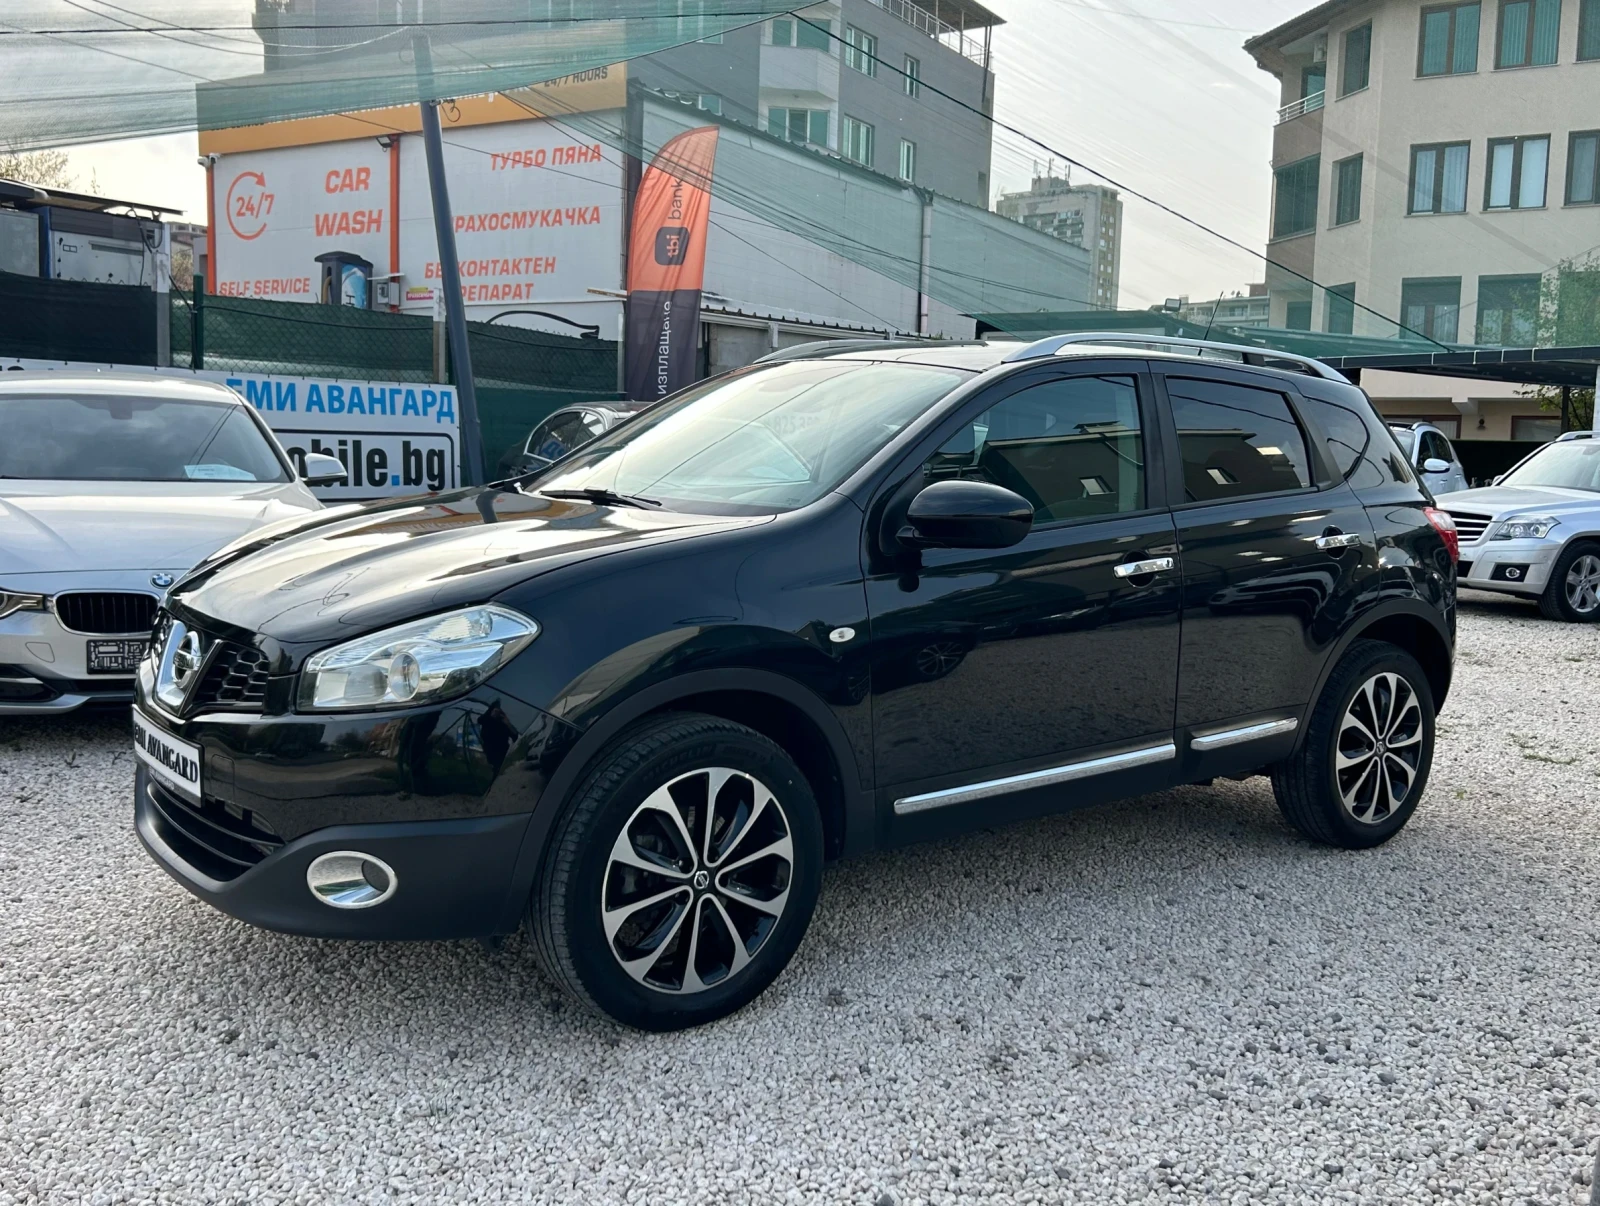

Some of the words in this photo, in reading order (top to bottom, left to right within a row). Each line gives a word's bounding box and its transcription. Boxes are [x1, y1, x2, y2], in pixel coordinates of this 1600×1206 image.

[572, 66, 608, 84] HOURS
[490, 148, 547, 171] ТУРБО
[552, 144, 602, 166] ПЯНА
[324, 166, 371, 194] CAR
[236, 194, 275, 218] 24/7
[667, 178, 684, 220] bank
[314, 209, 384, 238] WASH
[453, 206, 601, 233] РАХОСМУКАЧКА
[666, 234, 680, 258] tbi
[424, 256, 557, 280] БЕКОНТАКТЕН
[219, 280, 251, 297] SELF
[253, 277, 311, 296] SERVICE
[460, 282, 535, 302] РЕПАРАТ
[305, 383, 455, 424] АВАНГАРД
[147, 733, 199, 783] AVANGARD
